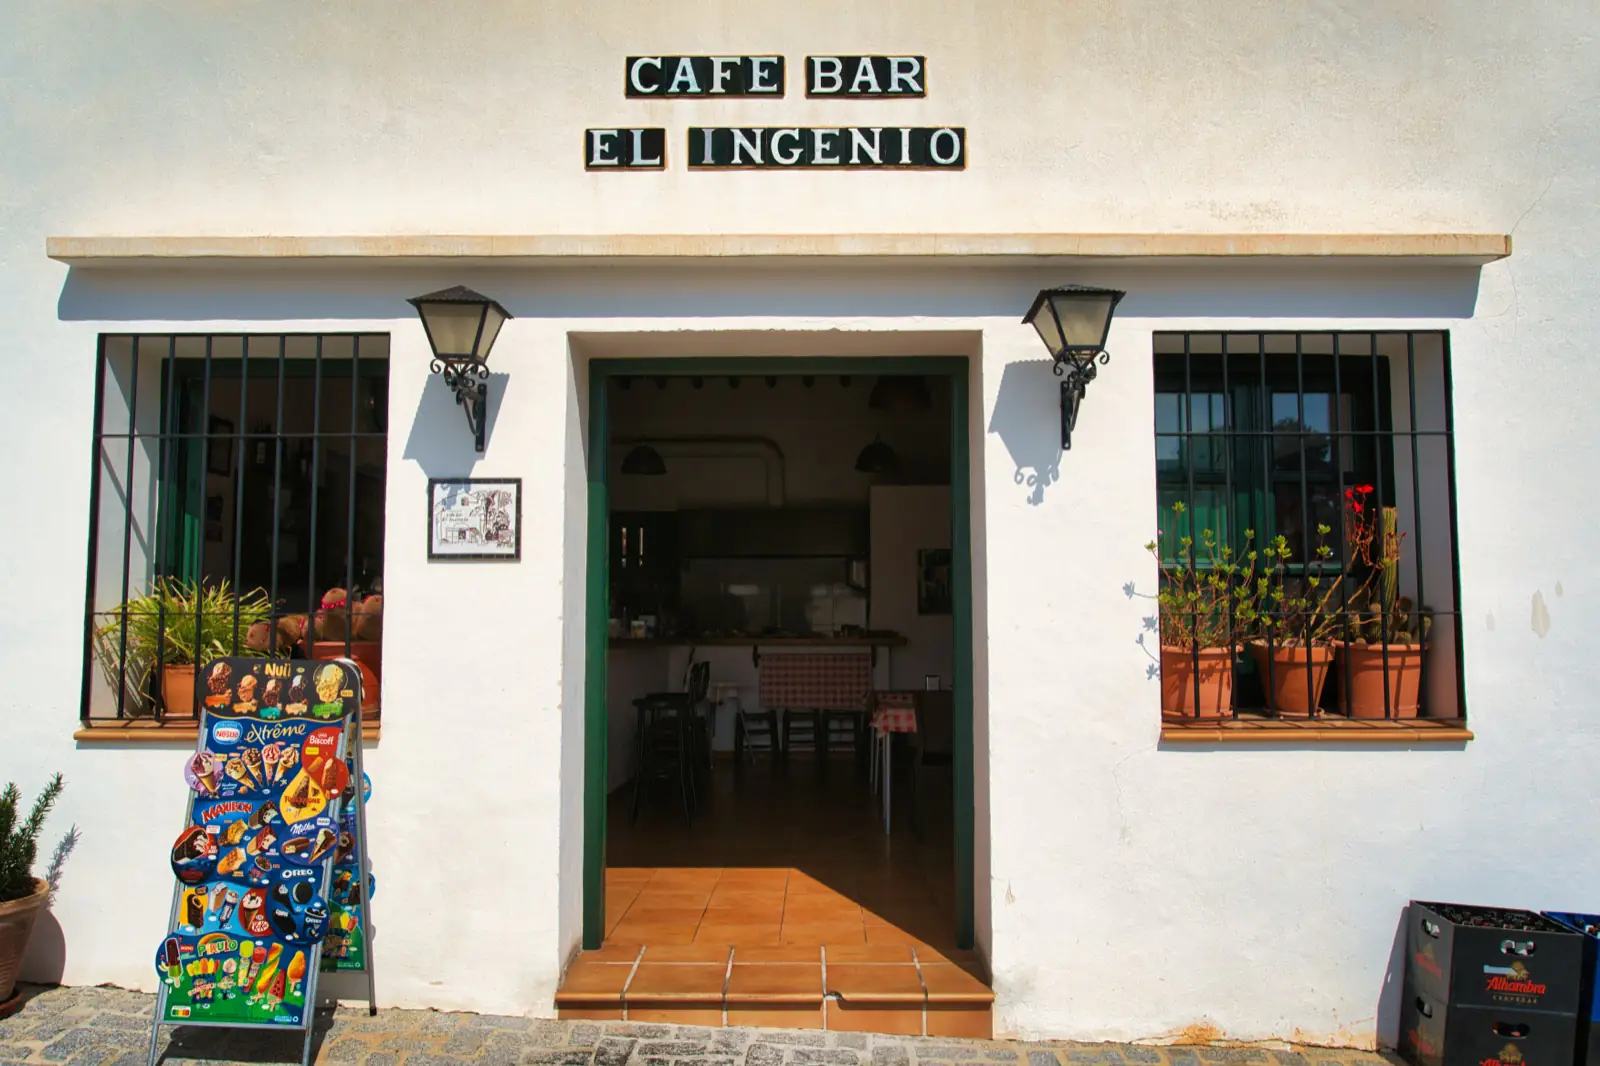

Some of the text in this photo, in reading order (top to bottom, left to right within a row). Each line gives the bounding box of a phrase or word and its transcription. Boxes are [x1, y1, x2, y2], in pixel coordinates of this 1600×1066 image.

[630, 56, 923, 94] CAFE BAR
[588, 128, 961, 166] EL INGENIO
[309, 735, 335, 745] Biscoff
[201, 801, 253, 824] MAXIBON
[290, 822, 316, 835] Milka
[282, 868, 314, 879] OREO
[197, 939, 239, 957] PIRULO
[1485, 976, 1547, 995] Alhambra
